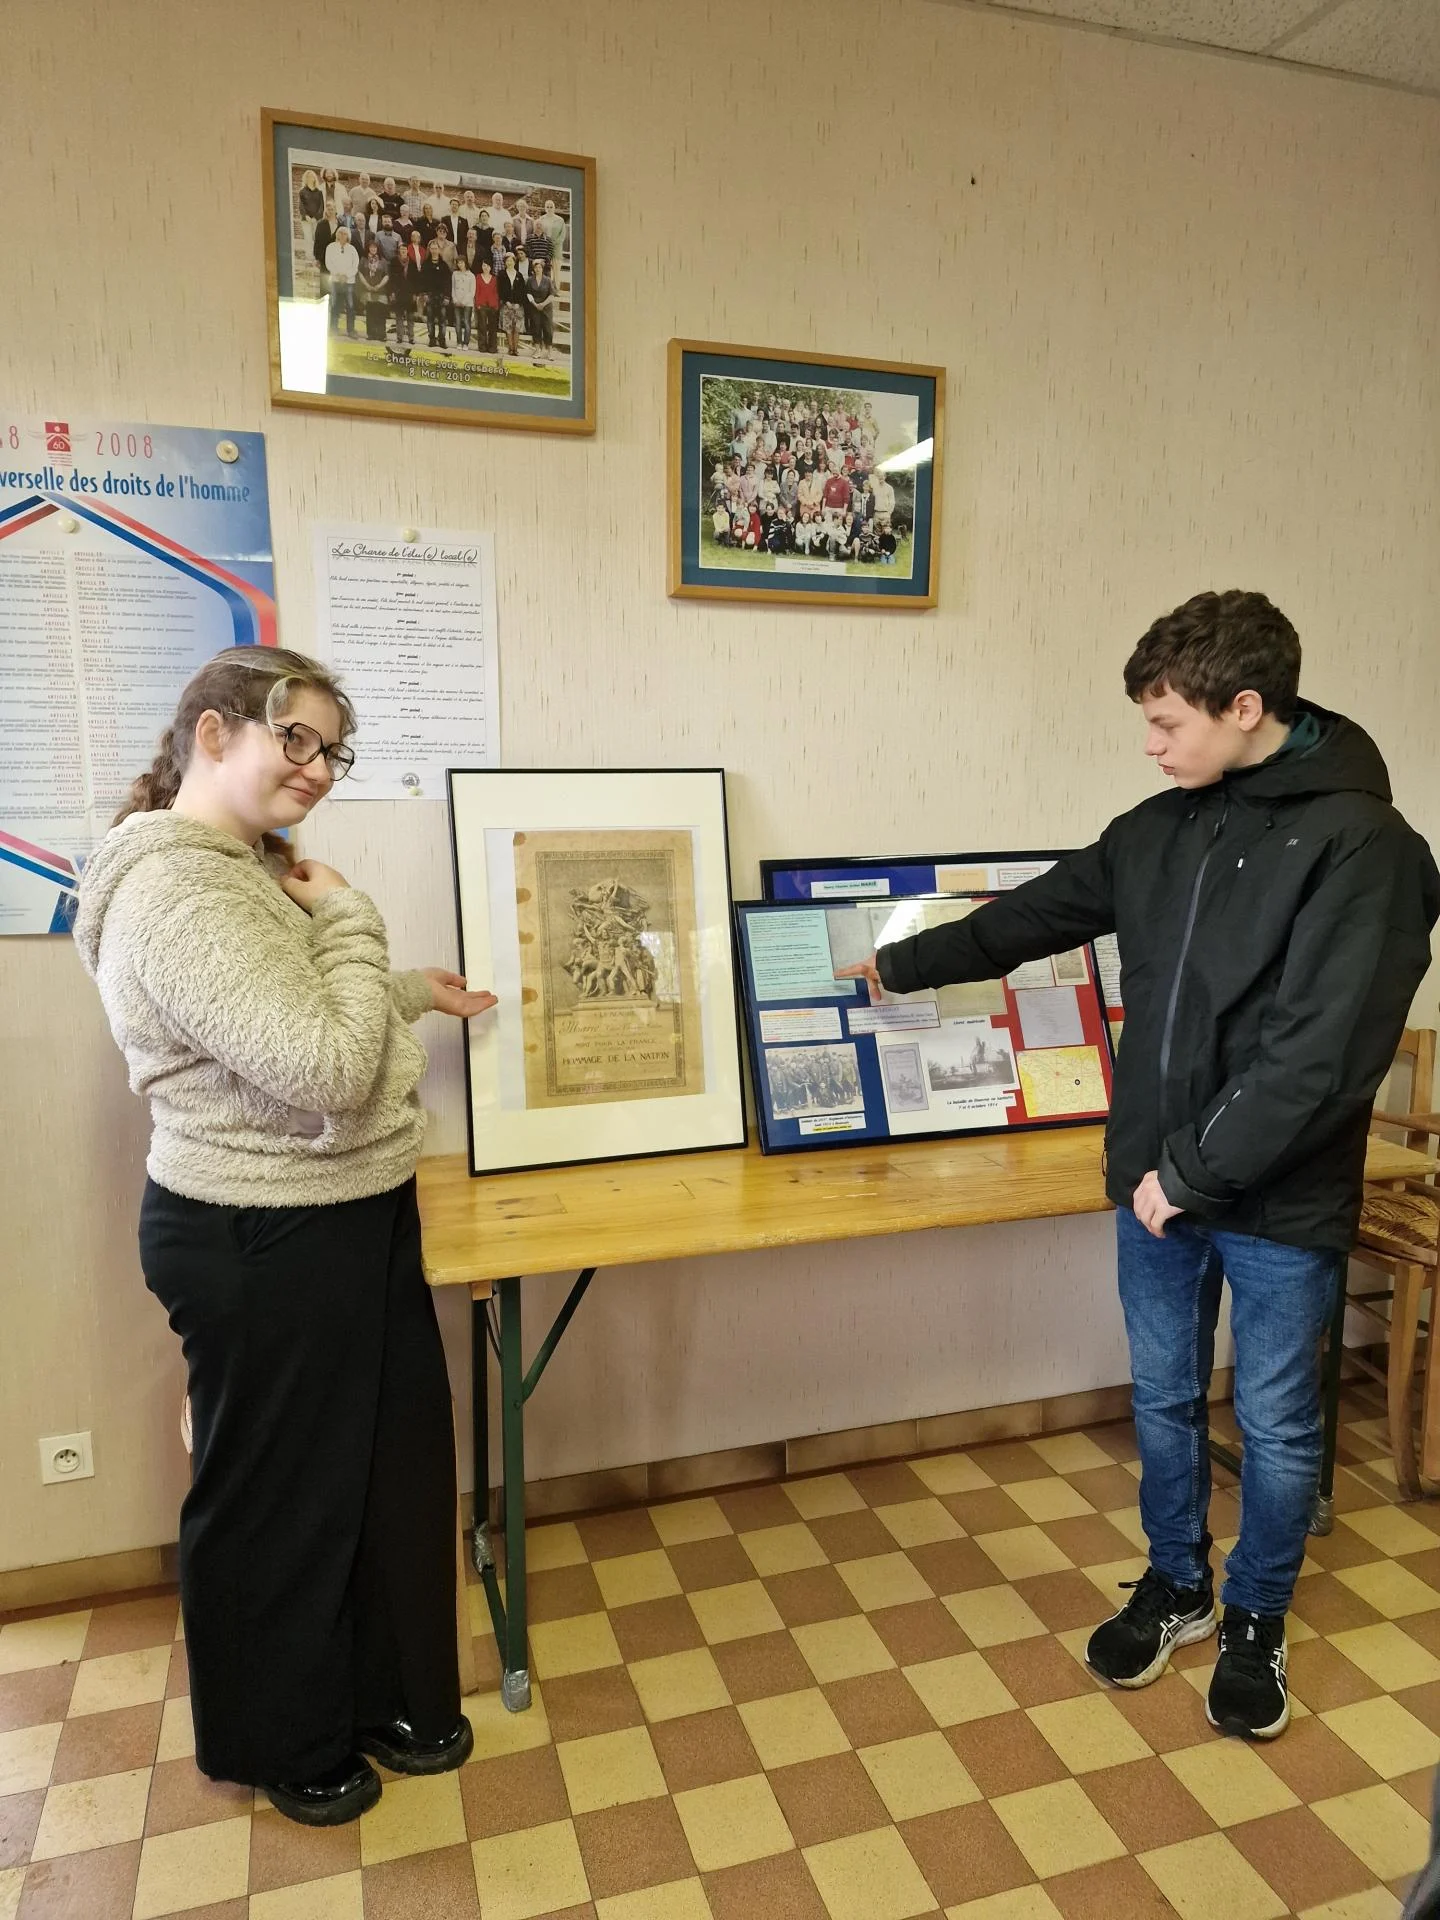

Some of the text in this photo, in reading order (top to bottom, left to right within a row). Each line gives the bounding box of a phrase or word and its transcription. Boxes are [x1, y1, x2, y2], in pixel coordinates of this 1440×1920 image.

[367, 352, 379, 361] La
[385, 353, 430, 367] Chapelle
[436, 360, 458, 370] sous
[408, 368, 471, 382] 8 Mai 2010
[96, 432, 154, 459] 2008
[70, 468, 98, 493] des
[103, 472, 150, 497] droits
[156, 474, 174, 498] de
[179, 475, 250, 502] l'homme
[332, 542, 350, 554] La
[388, 547, 400, 557] de
[562, 1056, 602, 1065] HOMMAGE
[624, 1054, 636, 1062] LA
[640, 1052, 670, 1060] NATION
